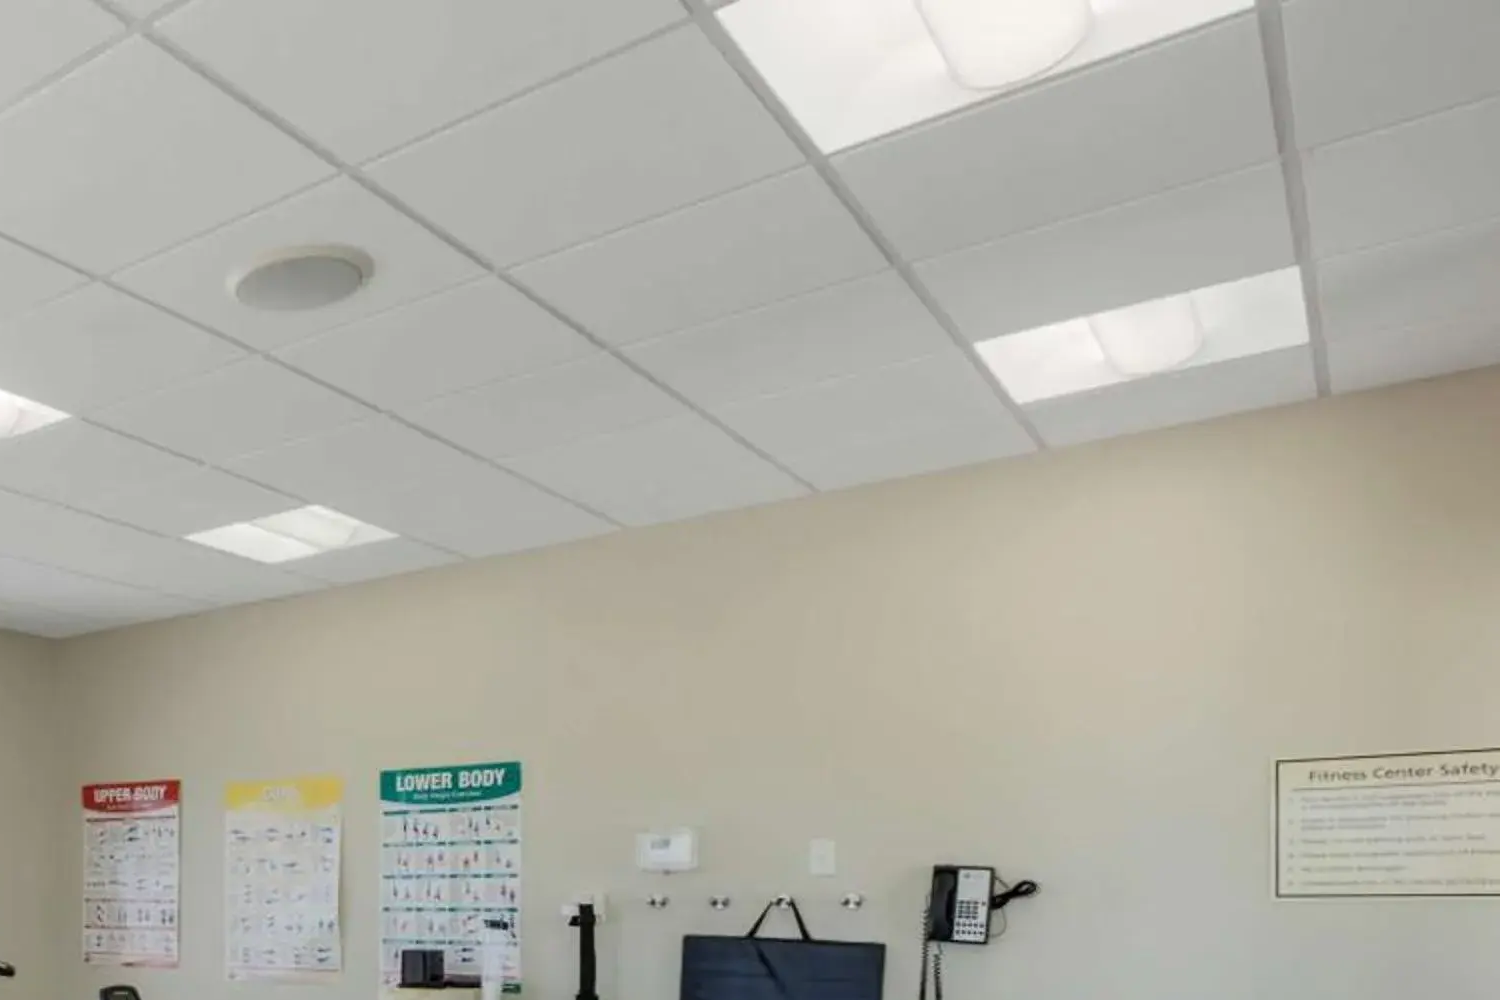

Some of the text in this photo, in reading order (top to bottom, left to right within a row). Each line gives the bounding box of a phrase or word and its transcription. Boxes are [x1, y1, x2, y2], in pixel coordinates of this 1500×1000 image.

[396, 767, 506, 792] LOWER BODY
[1308, 761, 1500, 782] Fitness Center Safety
[94, 785, 167, 803] UPPER BODY
